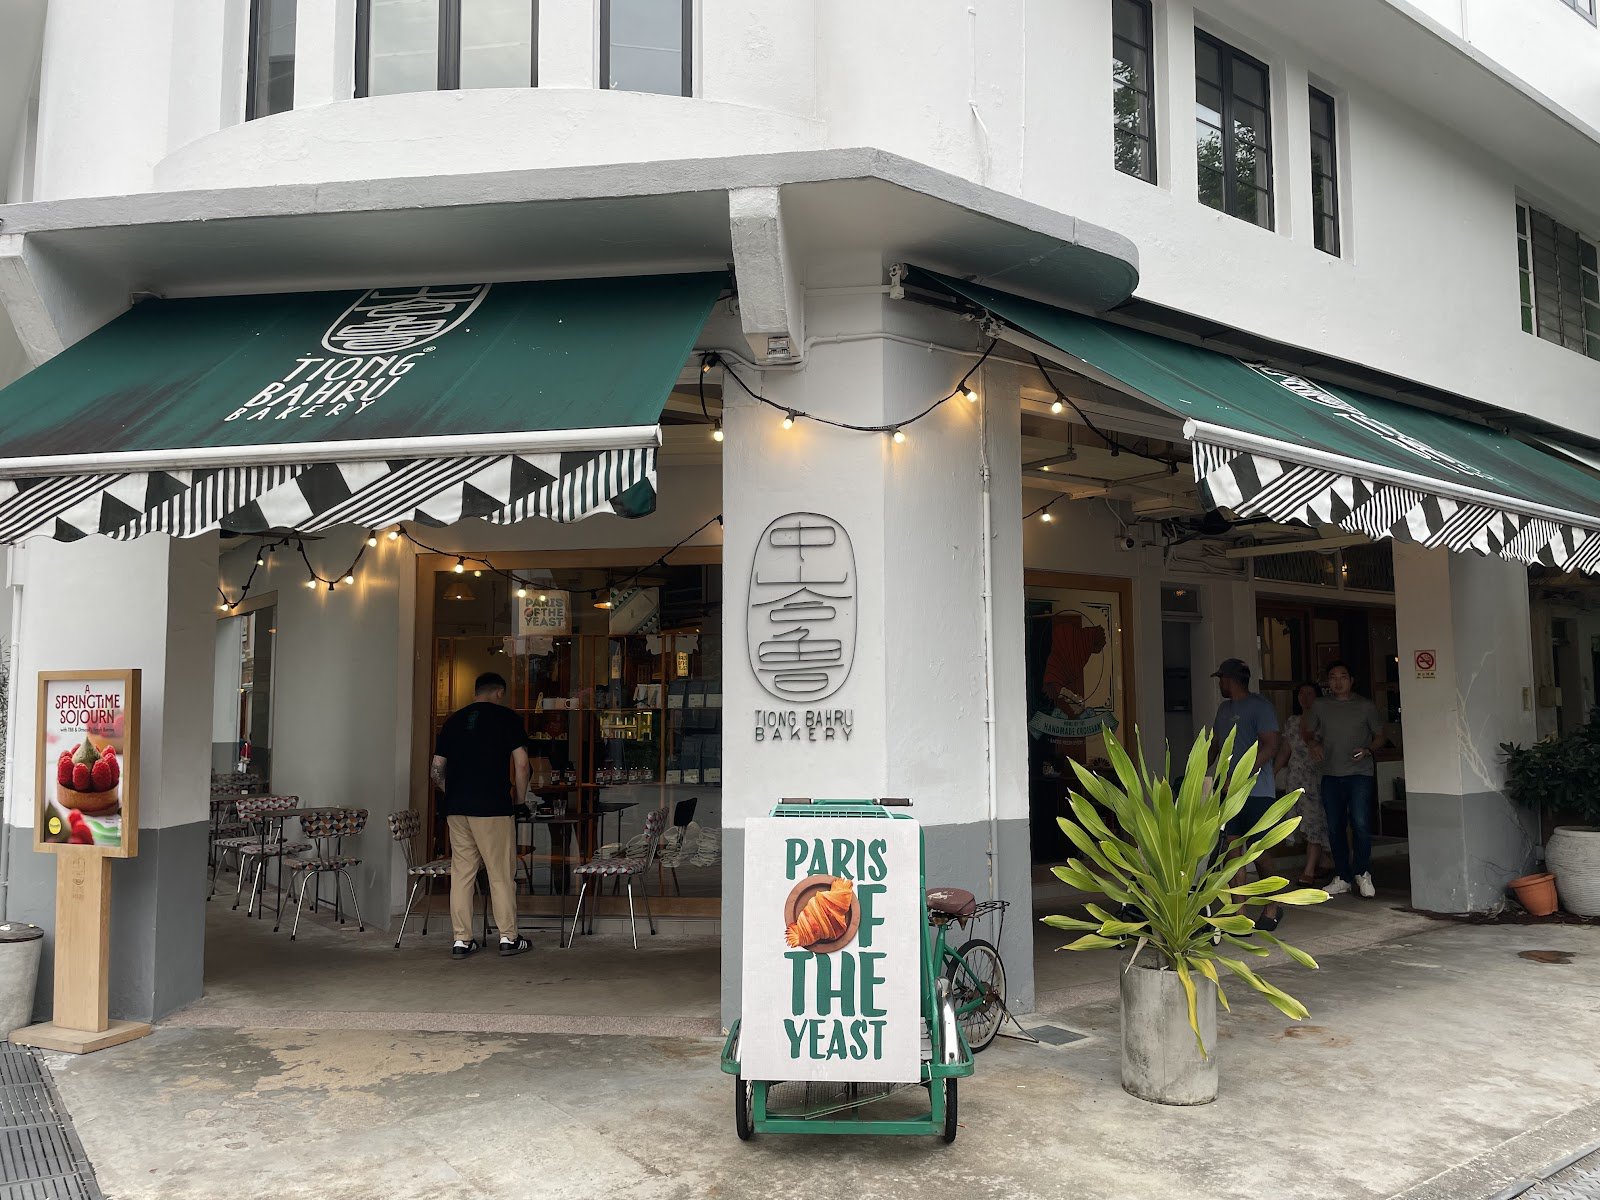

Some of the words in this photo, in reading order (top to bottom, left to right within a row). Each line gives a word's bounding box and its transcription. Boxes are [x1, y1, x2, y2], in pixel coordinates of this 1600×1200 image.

[283, 354, 425, 382] TIONG
[244, 376, 401, 407] BAHRU
[224, 400, 375, 421] BAKERY
[525, 598, 564, 607] PARIS
[541, 608, 564, 617] THE
[525, 617, 564, 626] YEAST
[84, 684, 91, 694] A
[60, 709, 115, 726] SOJOURN
[755, 710, 796, 727] TIONG
[805, 710, 853, 727] BAHRU
[755, 727, 853, 741] BAKERY
[784, 838, 888, 881] PARIS
[783, 951, 888, 1017] THE
[783, 1018, 888, 1061] YEAST
